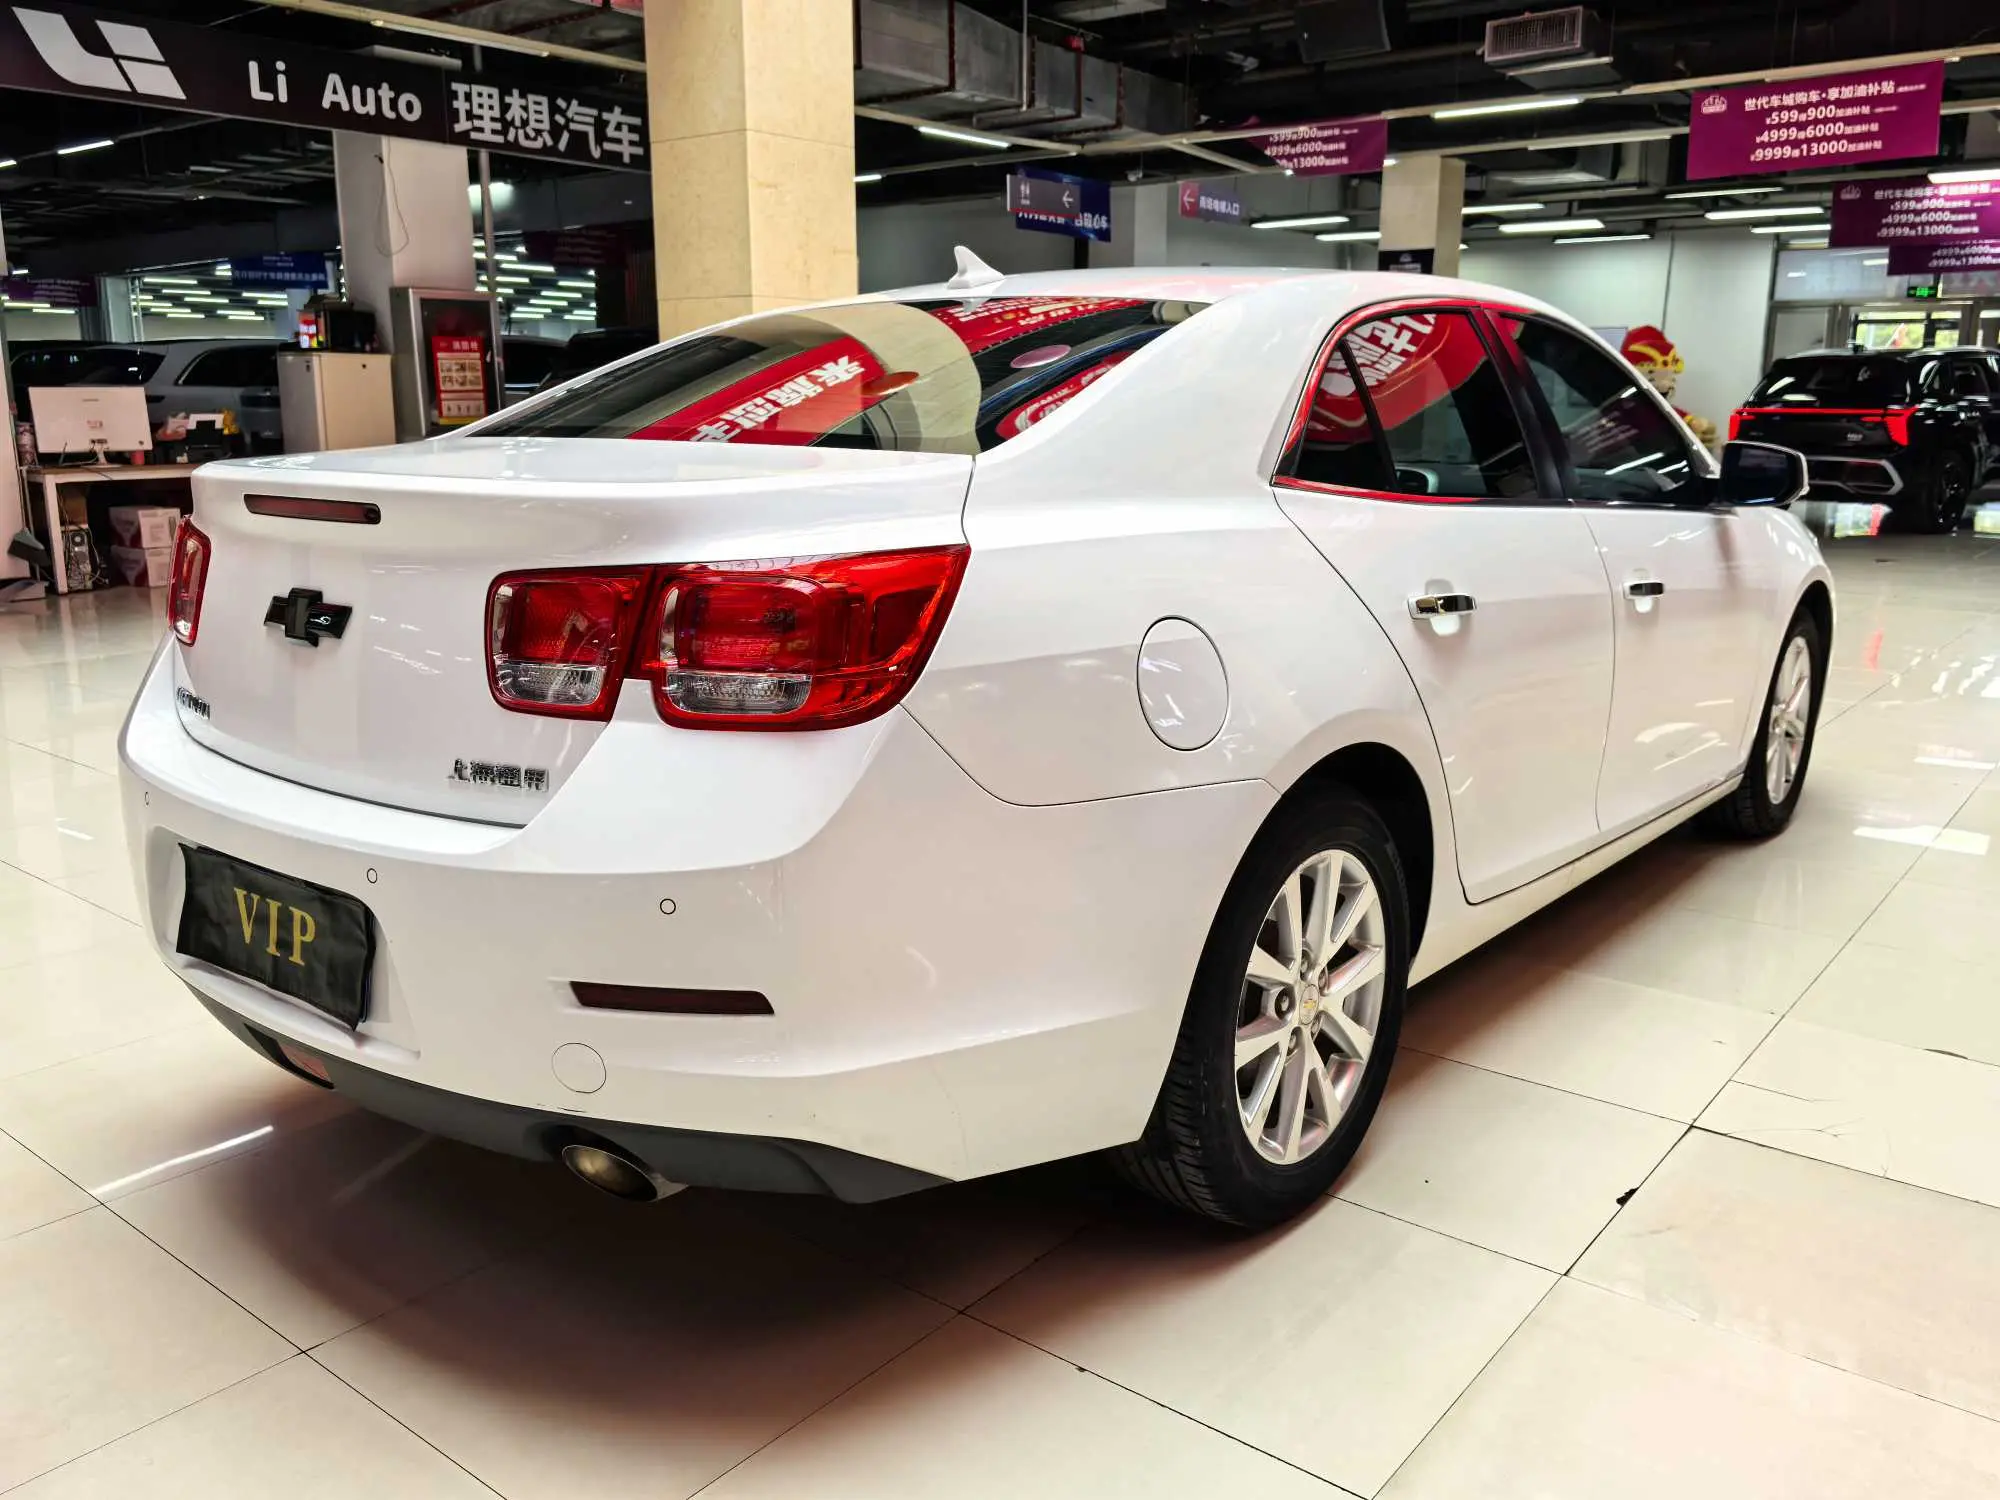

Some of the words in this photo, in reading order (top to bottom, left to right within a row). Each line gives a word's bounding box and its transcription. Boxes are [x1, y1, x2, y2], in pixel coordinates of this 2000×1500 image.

[247, 60, 288, 103] Li
[321, 72, 423, 122] Auto
[450, 81, 644, 164] 理想汽车
[233, 887, 316, 967] VIP
